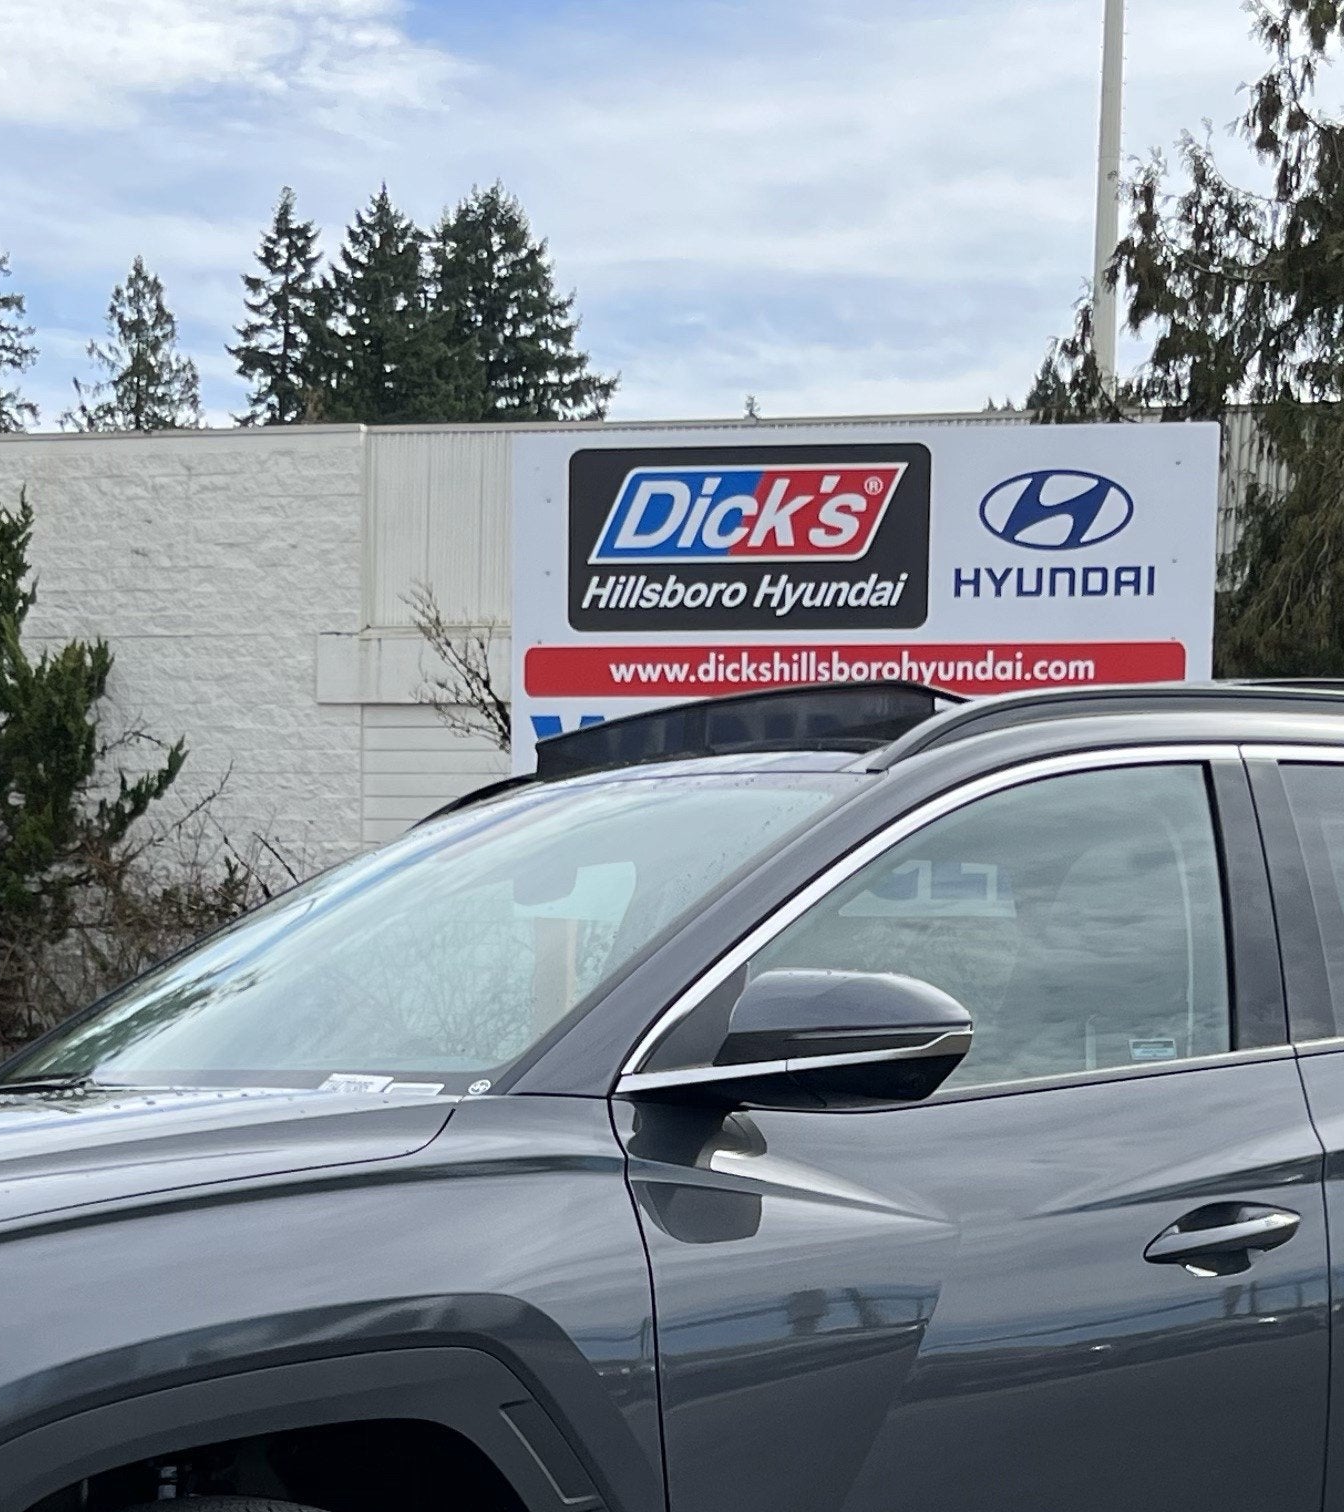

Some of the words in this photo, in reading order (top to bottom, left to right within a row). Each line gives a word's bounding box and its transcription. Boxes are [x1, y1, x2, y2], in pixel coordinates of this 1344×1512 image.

[613, 474, 868, 550] Dick's
[581, 574, 747, 611] Hillsboro
[753, 572, 909, 616] Hyundai
[953, 565, 1156, 598] HYUNDAI
[609, 653, 1095, 685] www.dickshillsborohyundai.com
